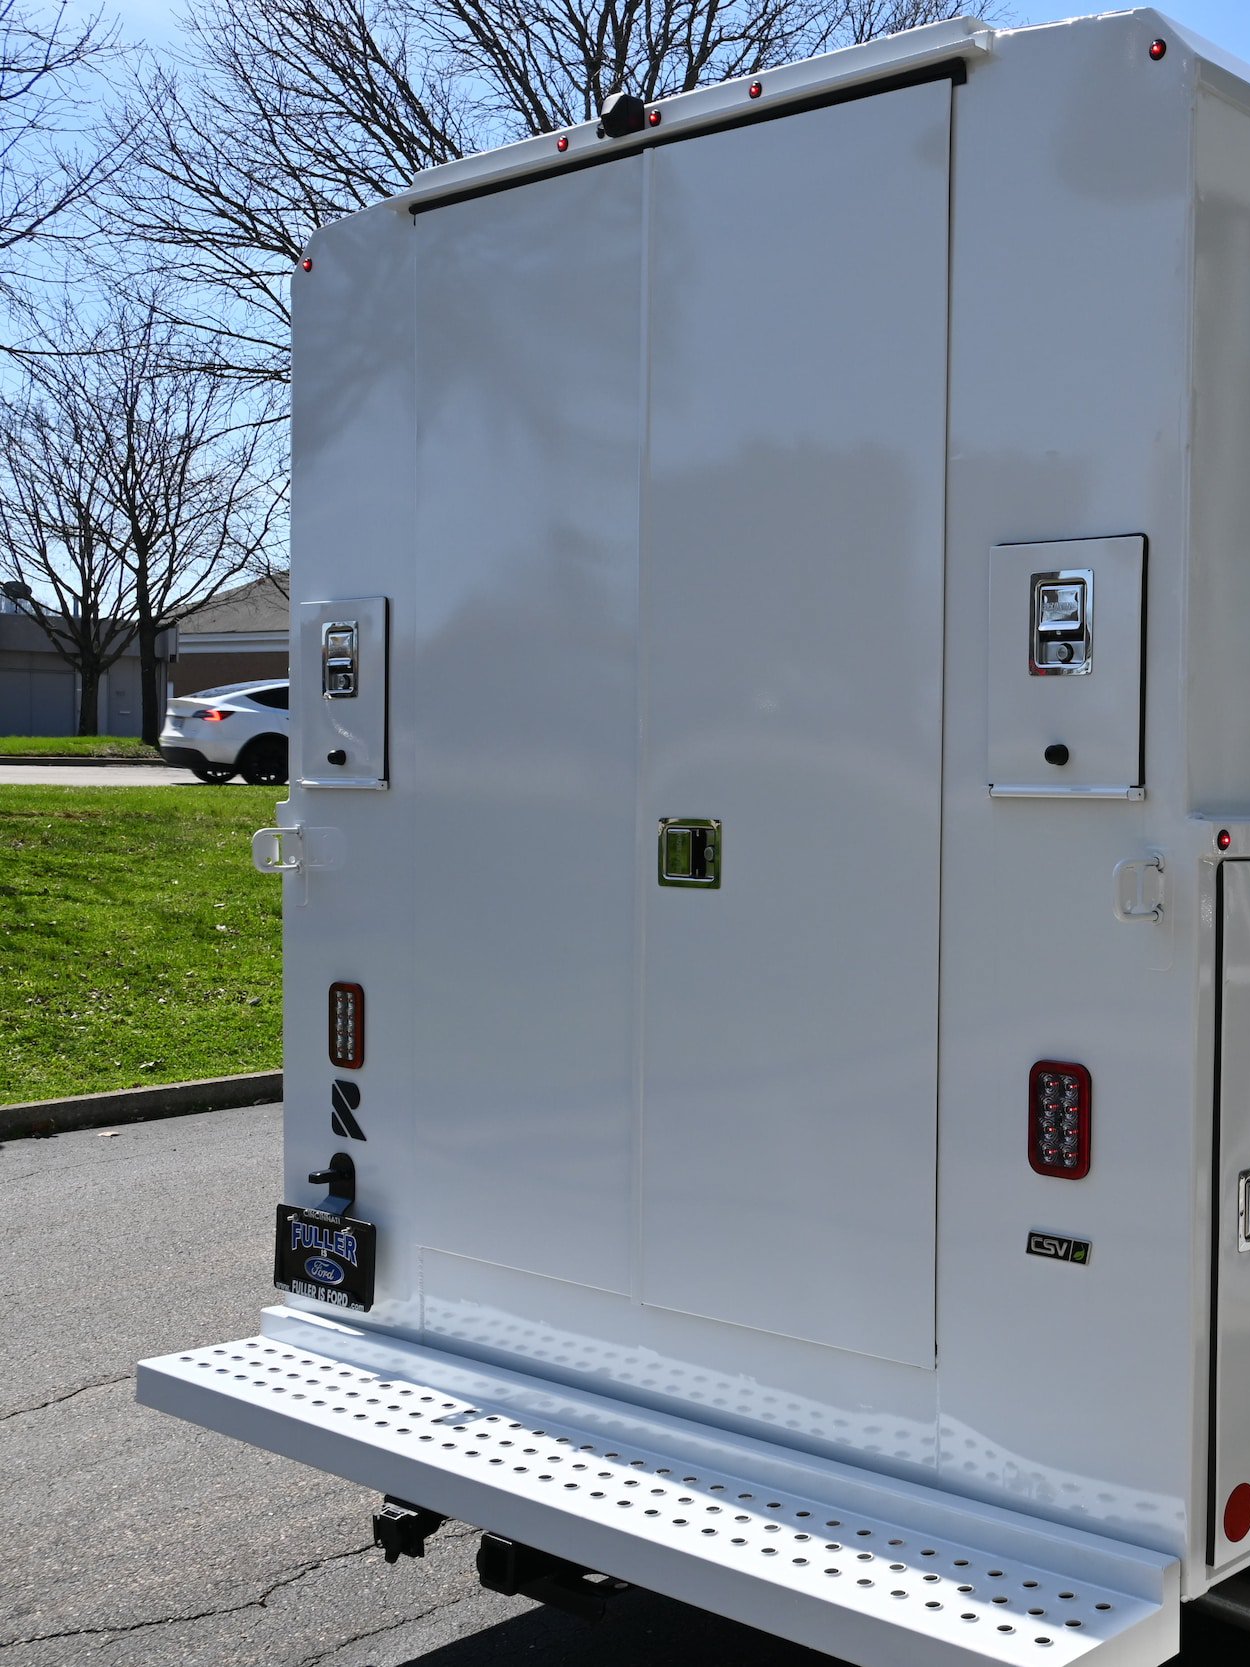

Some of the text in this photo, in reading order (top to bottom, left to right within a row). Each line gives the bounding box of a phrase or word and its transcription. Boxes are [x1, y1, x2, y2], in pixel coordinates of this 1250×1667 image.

[303, 1208, 341, 1225] CINCINNATI
[291, 1221, 358, 1268] FULLER
[1030, 1236, 1068, 1257] CSV
[311, 1260, 335, 1281] Ford
[291, 1279, 317, 1297] FULLER
[317, 1286, 326, 1302] IS
[326, 1289, 349, 1308] FORD
[349, 1302, 365, 1312] .com
